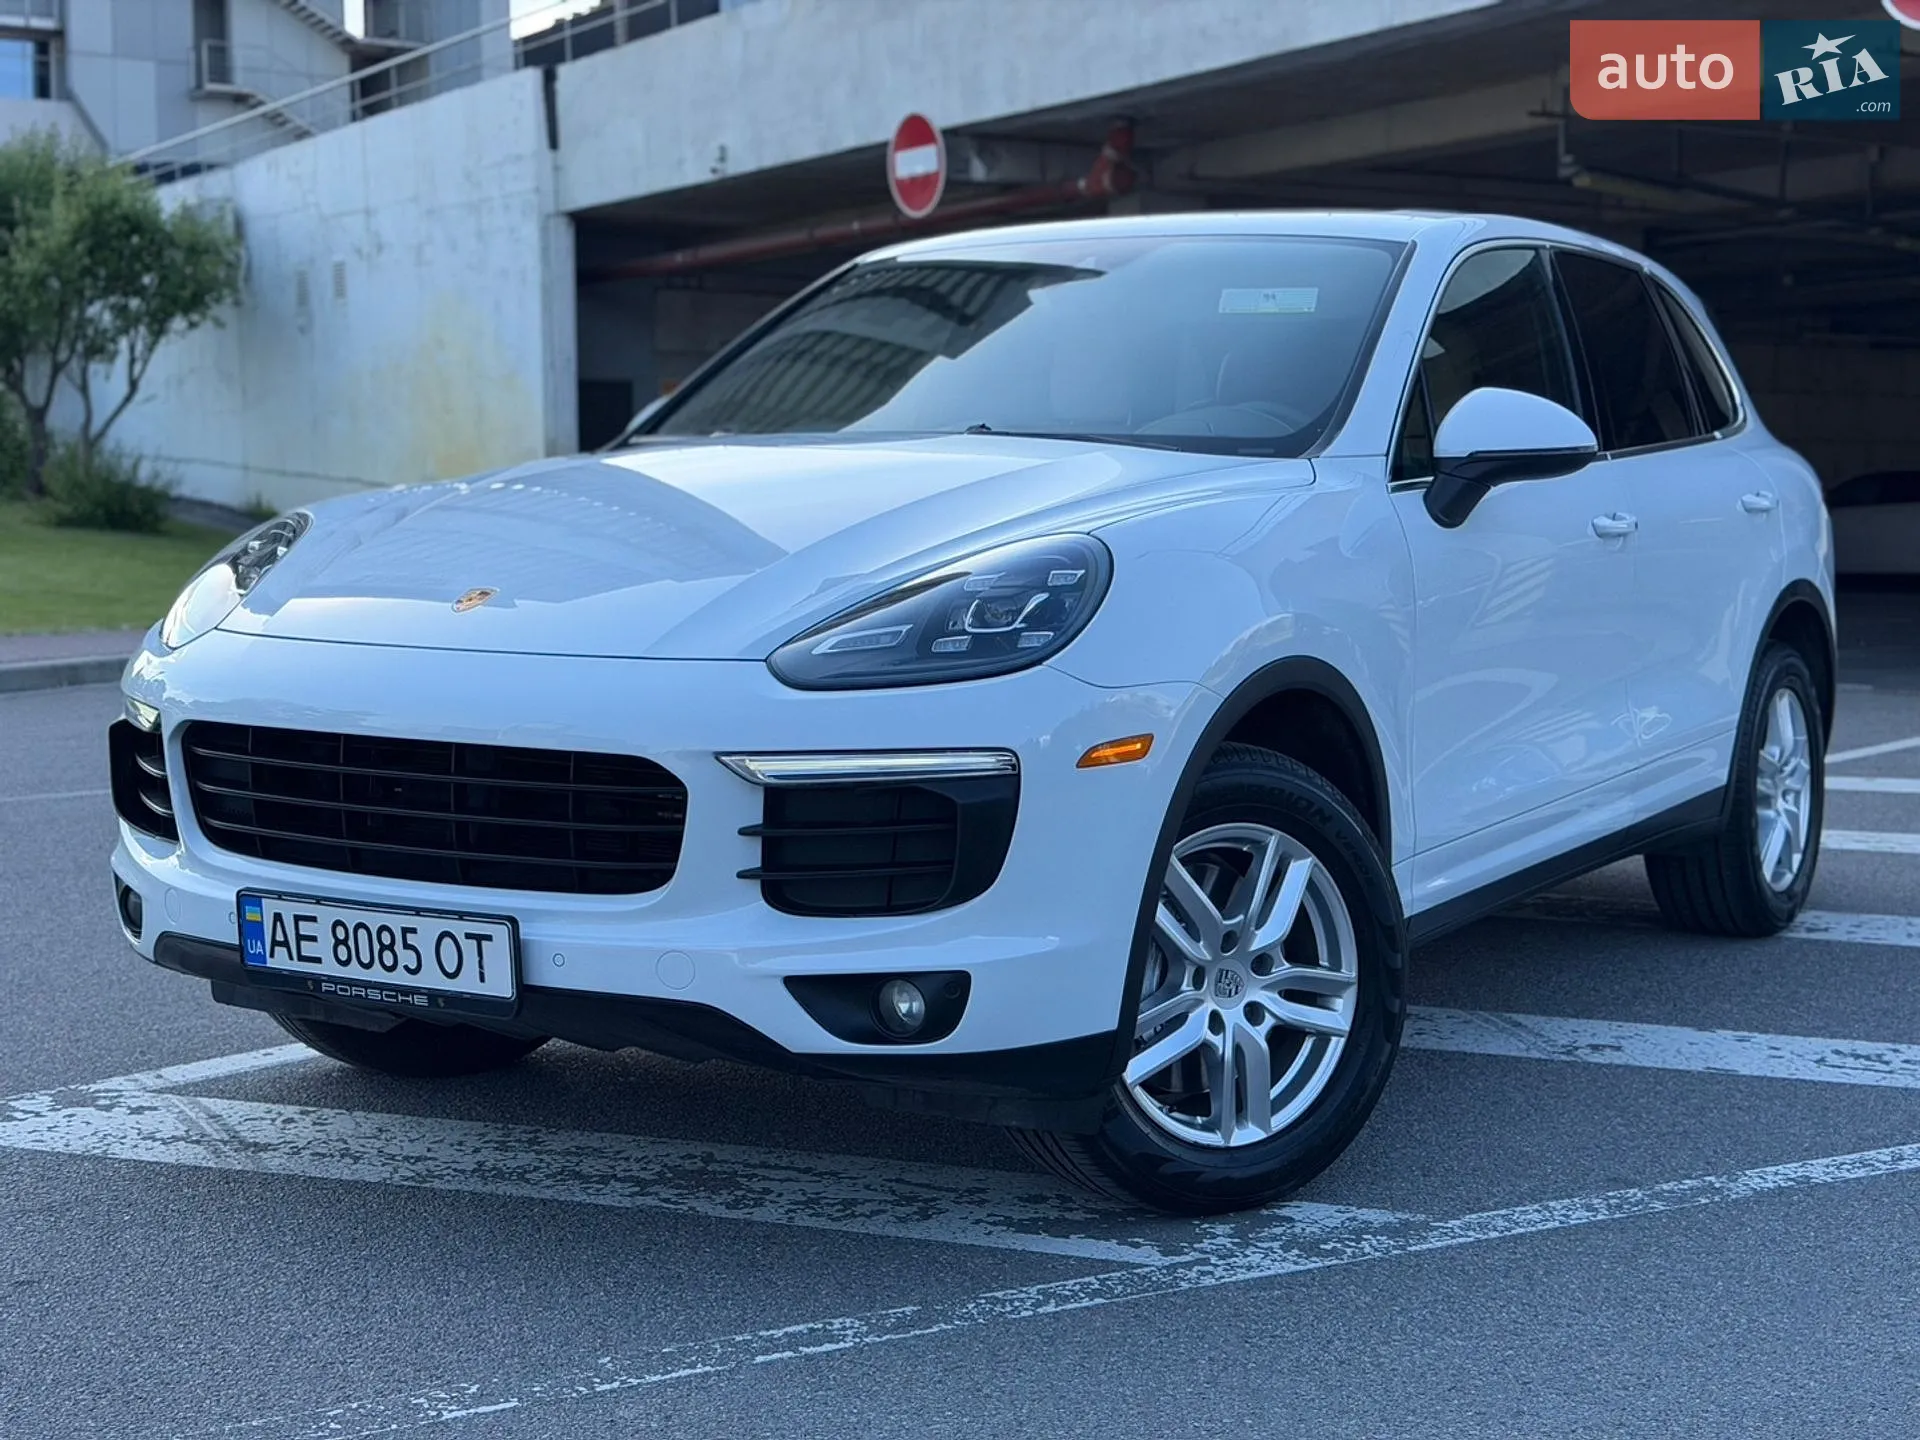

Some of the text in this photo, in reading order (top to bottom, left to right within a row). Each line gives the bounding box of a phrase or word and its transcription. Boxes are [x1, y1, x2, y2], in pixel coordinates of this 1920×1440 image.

[247, 938, 264, 956] UA
[269, 912, 493, 984] AE 8085 OT
[321, 982, 429, 1007] PORSCHE
